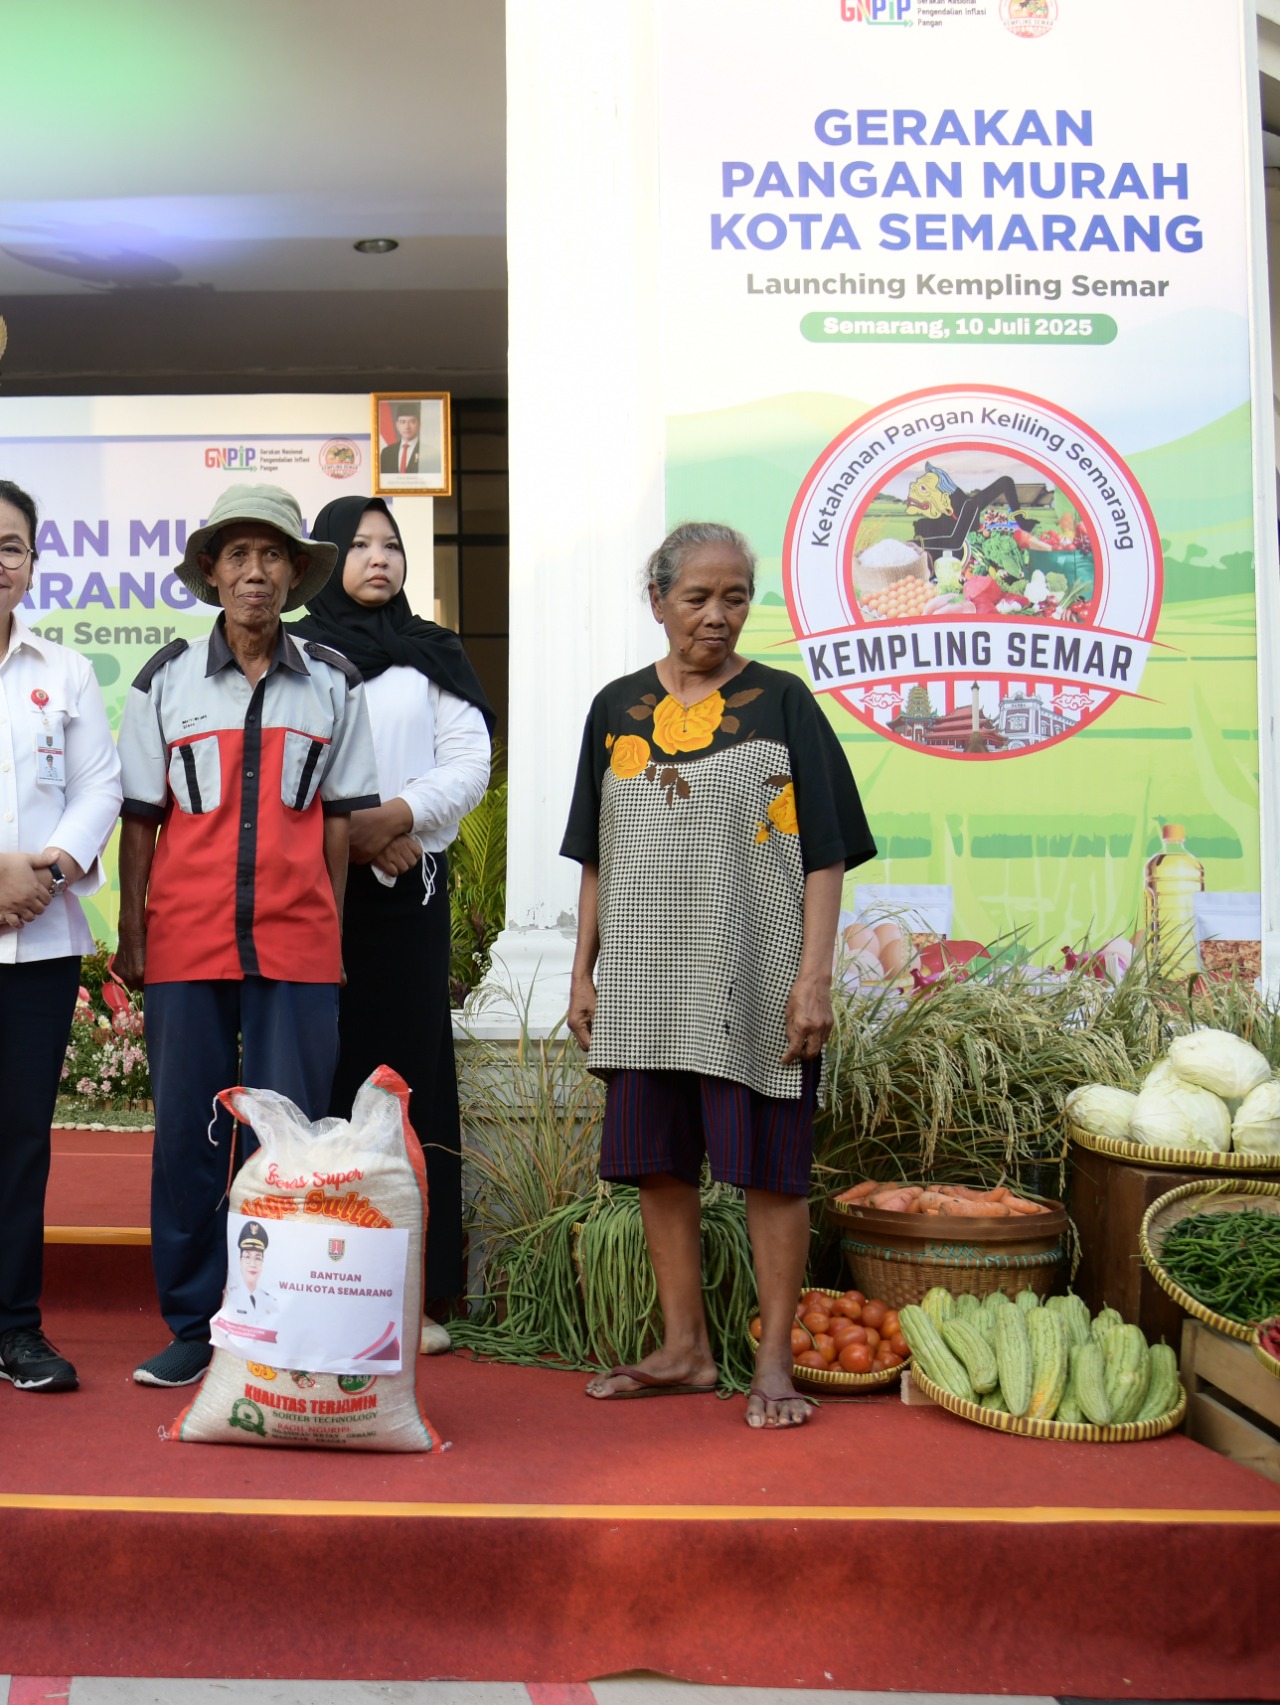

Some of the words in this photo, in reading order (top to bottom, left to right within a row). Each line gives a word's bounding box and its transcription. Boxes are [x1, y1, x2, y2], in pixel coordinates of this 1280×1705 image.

[917, 7, 963, 17] Pengendalian
[965, 7, 987, 16] Inflasi
[917, 18, 943, 28] Pangan
[814, 108, 1093, 147] GERAKAN
[720, 160, 962, 199] PANGAN
[983, 162, 1189, 200] MURAH
[710, 213, 861, 251] KOTA
[878, 213, 1203, 254] SEMARANG
[746, 272, 906, 299] Launching
[915, 273, 1063, 300] Kempling
[1071, 274, 1169, 297] Semar
[823, 317, 950, 340] Semarang,
[955, 318, 983, 336] 10
[987, 318, 1031, 336] Juli
[1035, 318, 1093, 336] 2025
[260, 456, 293, 464] Pengendalian
[260, 464, 278, 472] Pangan
[811, 440, 885, 548] Ketahanan
[884, 407, 974, 446] Pangan
[981, 407, 1065, 452] Keliling
[1064, 442, 1134, 551] Semarang
[74, 622, 176, 645] Semar
[808, 631, 993, 681] KEMPLING
[1008, 631, 1133, 681] SEMAR
[312, 1168, 364, 1191] Super
[310, 1270, 362, 1283] BANTUAN
[279, 1281, 306, 1293] WALI
[306, 1283, 336, 1295] KOTA
[337, 1285, 394, 1298] SEMARANG
[244, 1383, 307, 1414] KUALITAS
[310, 1394, 377, 1415] TERJAMIN
[272, 1410, 310, 1422] SORTER
[313, 1410, 378, 1423] TECHNOLOGY
